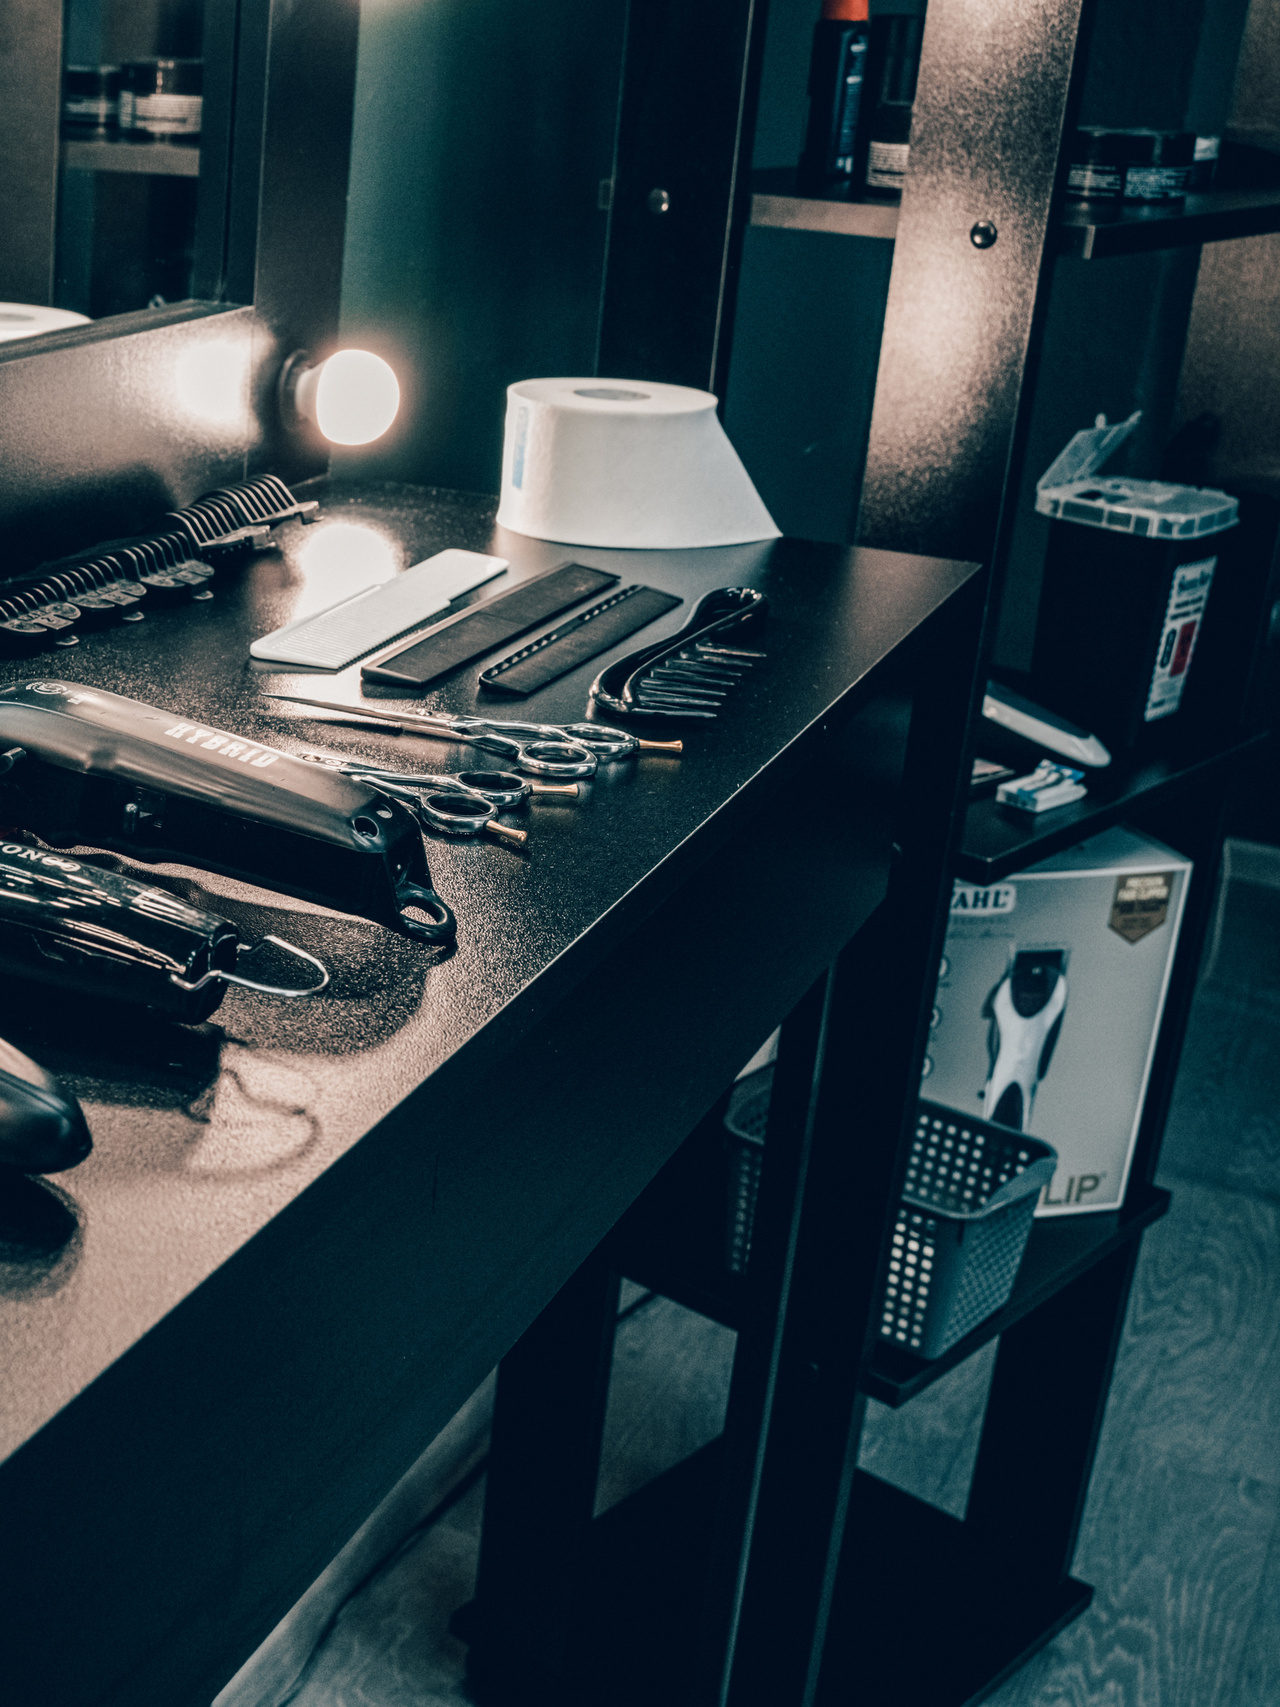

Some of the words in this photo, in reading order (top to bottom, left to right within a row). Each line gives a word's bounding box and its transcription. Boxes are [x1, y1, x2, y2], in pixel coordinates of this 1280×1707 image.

[164, 722, 280, 768] HYBRID
[952, 890, 1008, 909] AHL
[1043, 1174, 1100, 1206] LIP
